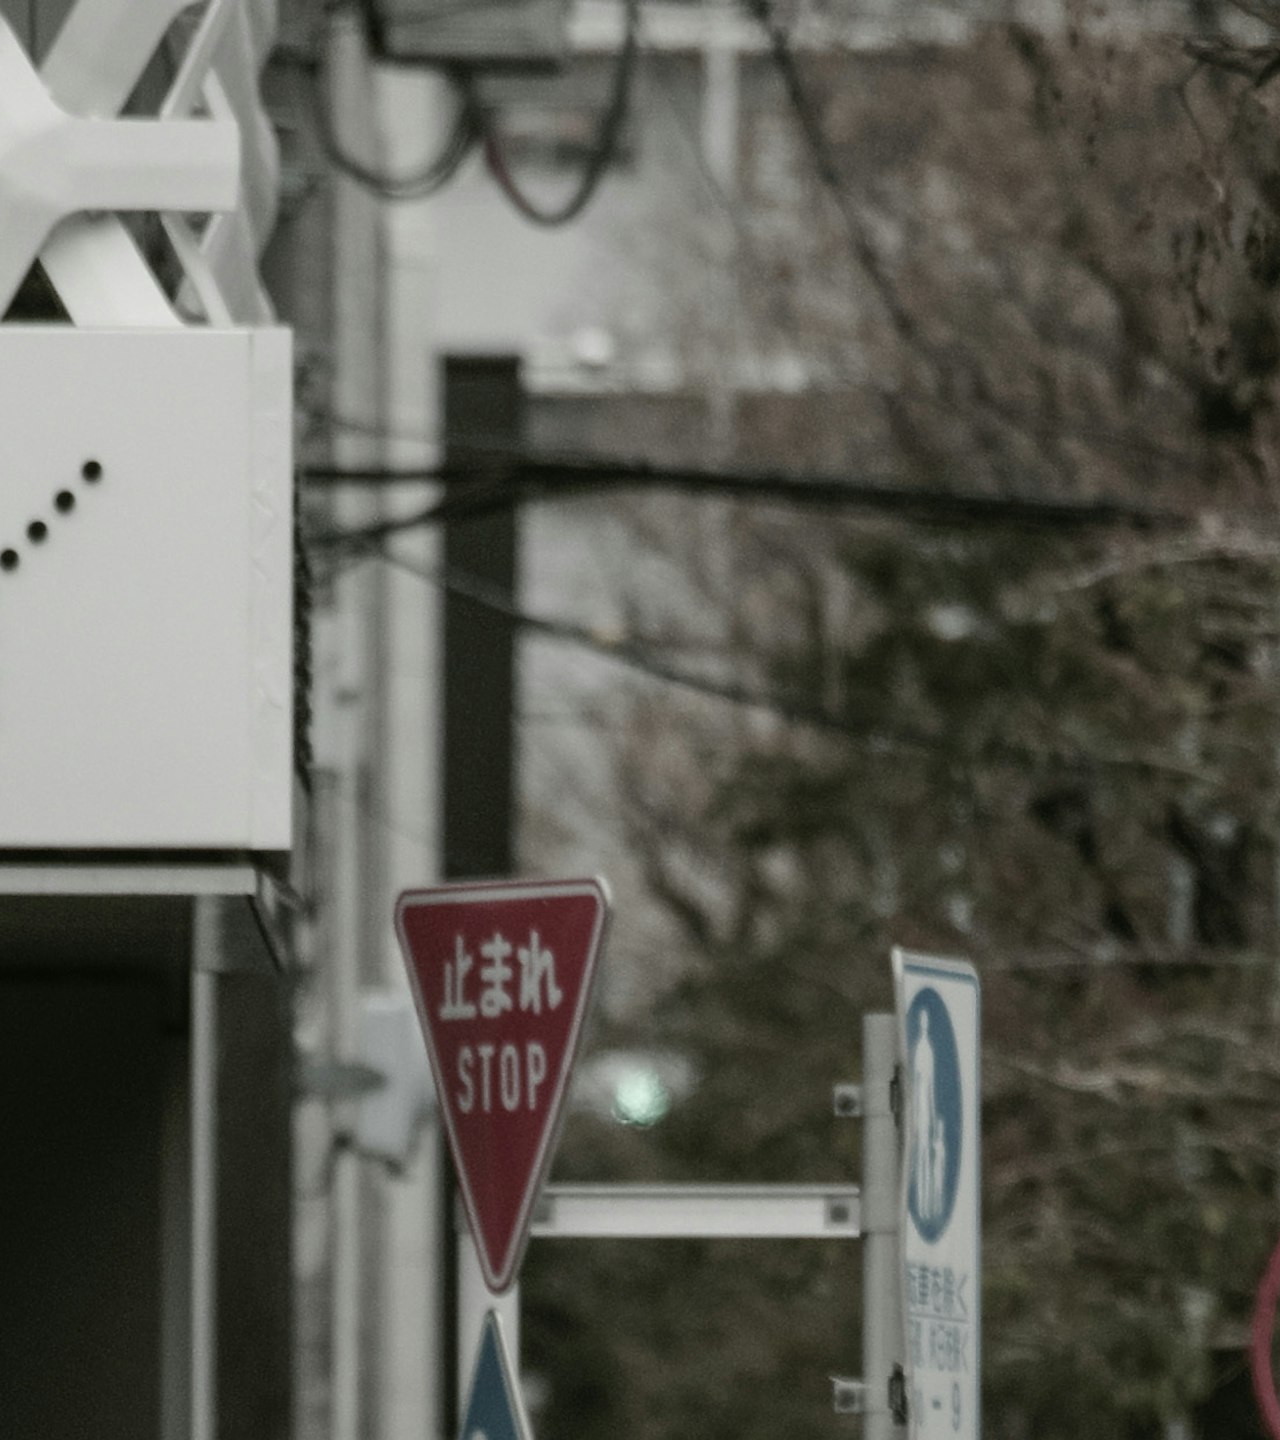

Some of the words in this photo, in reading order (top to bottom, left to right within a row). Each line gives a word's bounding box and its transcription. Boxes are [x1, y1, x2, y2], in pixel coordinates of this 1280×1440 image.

[438, 930, 563, 1020] 止まれ
[457, 1042, 547, 1114] STOP
